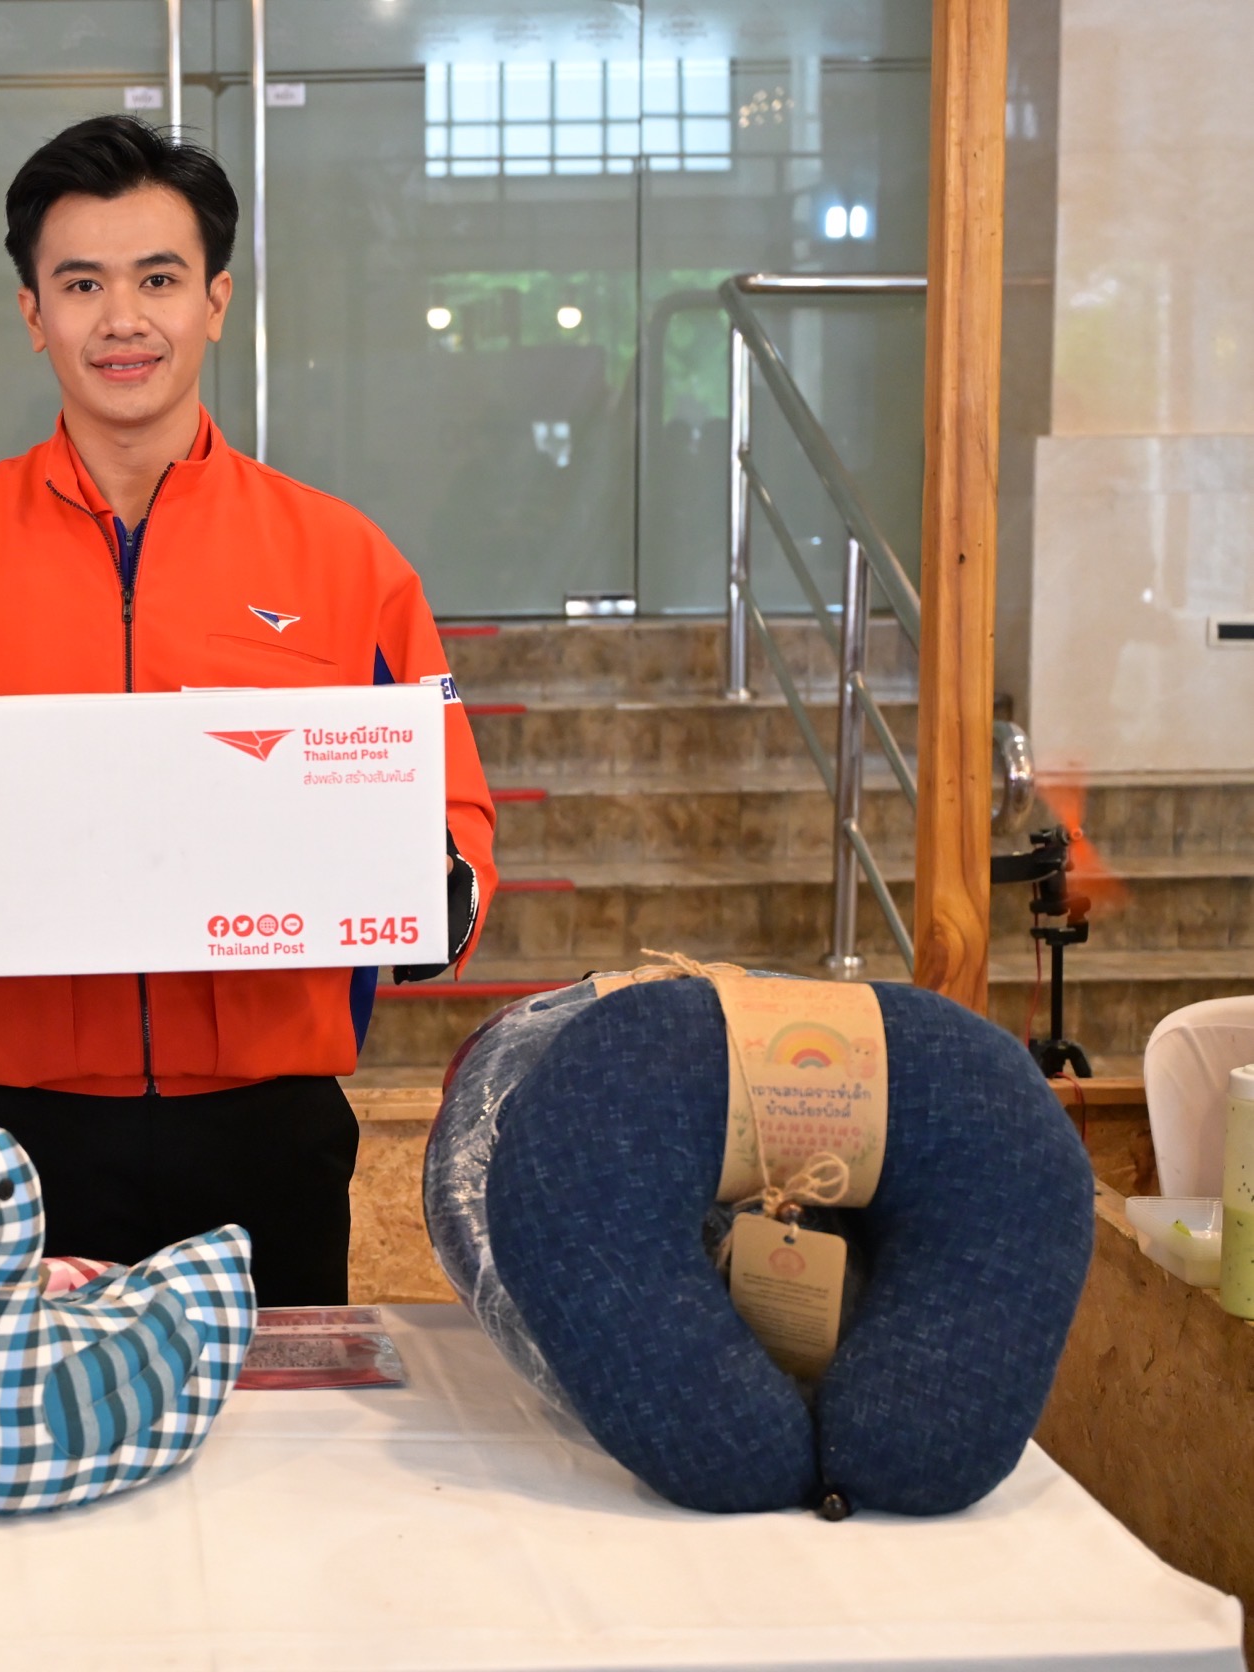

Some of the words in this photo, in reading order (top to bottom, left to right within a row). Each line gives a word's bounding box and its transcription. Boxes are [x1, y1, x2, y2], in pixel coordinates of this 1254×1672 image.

[303, 725, 414, 746] ไปรษณีย์ไทย
[303, 750, 358, 762] Thailand
[361, 749, 389, 761] Post
[303, 769, 343, 785] ส่งพลัง
[345, 768, 416, 784] สร้างสัมพันธ์
[338, 916, 419, 946] 1545
[207, 943, 270, 957] Thailand
[274, 941, 305, 955] Post
